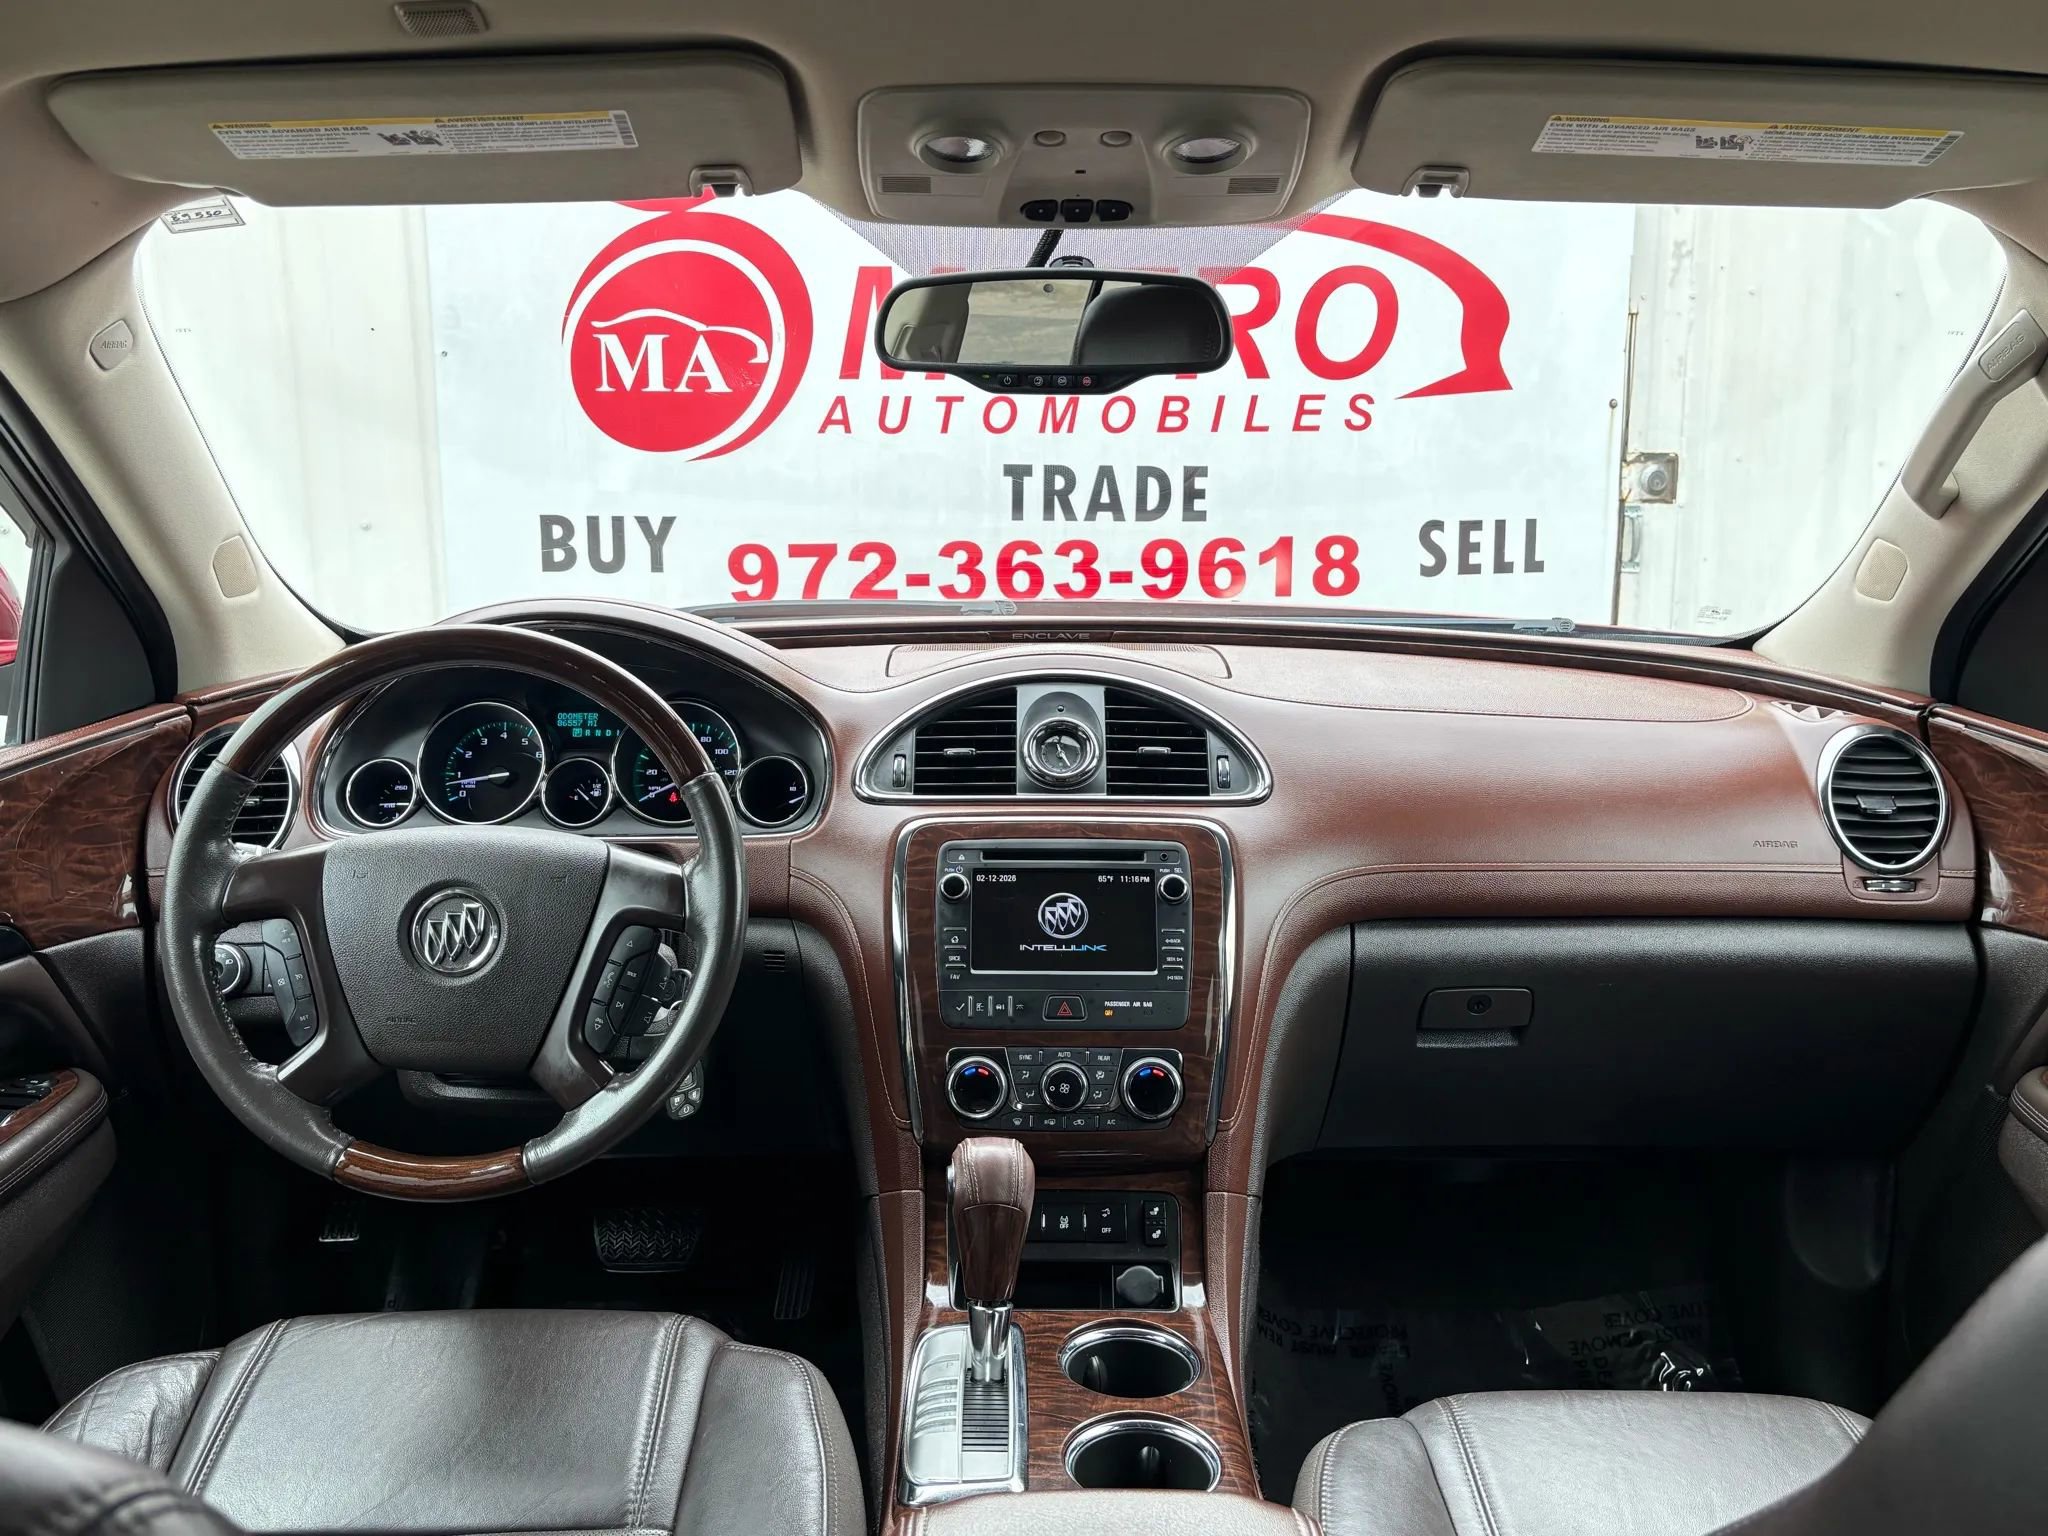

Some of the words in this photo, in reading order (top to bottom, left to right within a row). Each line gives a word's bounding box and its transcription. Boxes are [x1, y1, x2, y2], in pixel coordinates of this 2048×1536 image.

[838, 264, 1399, 381] MRO
[593, 333, 733, 393] MA
[1986, 334, 2026, 373] AIRBAG
[820, 392, 1375, 434] AUTOMOBILES
[1003, 464, 1208, 522] TRADE
[540, 514, 677, 574] BUY
[1420, 518, 1545, 577] SELL
[728, 535, 1360, 600] 972-363-9618
[1012, 632, 1091, 641] ENCLAVE
[499, 731, 508, 739] 4
[557, 712, 599, 720] ODOMETER
[464, 750, 473, 759] 2
[480, 737, 488, 746] 3
[521, 737, 529, 746] 5
[1752, 840, 1799, 849] AIRBAG
